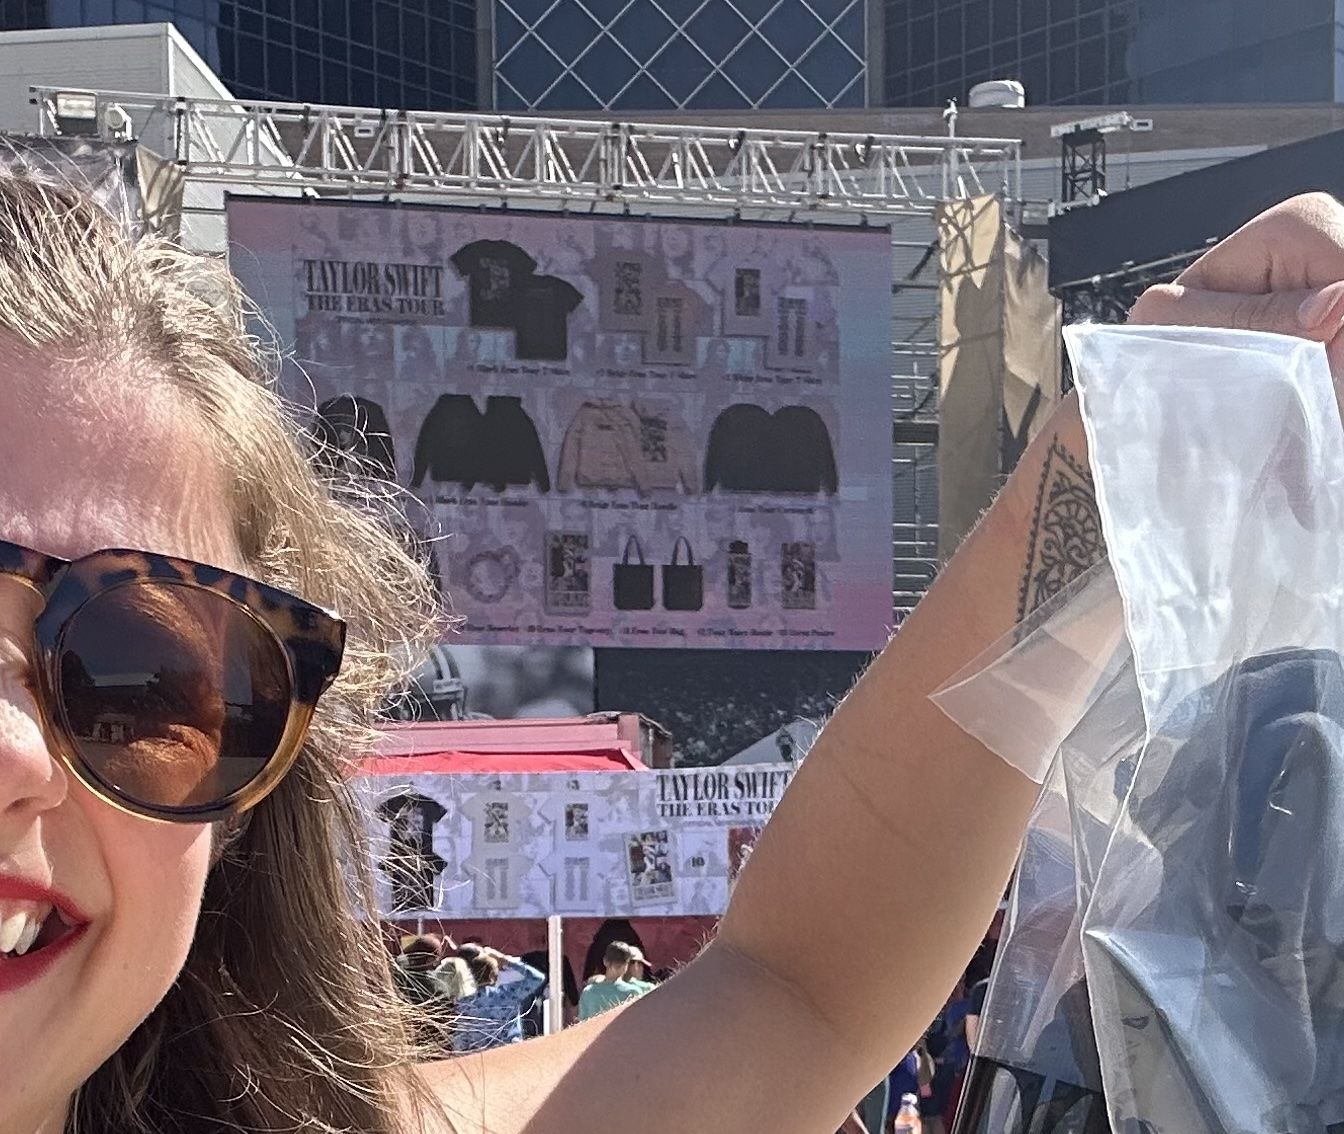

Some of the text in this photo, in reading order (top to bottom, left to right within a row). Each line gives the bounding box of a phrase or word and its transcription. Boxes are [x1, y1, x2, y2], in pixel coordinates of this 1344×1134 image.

[305, 259, 444, 298] TAYLOR SWIFT
[305, 294, 446, 316] THE ERAS TOUR
[657, 771, 730, 801] TAYLOR
[657, 802, 692, 817] THE
[697, 801, 741, 817] ERAS
[692, 856, 705, 868] 10
